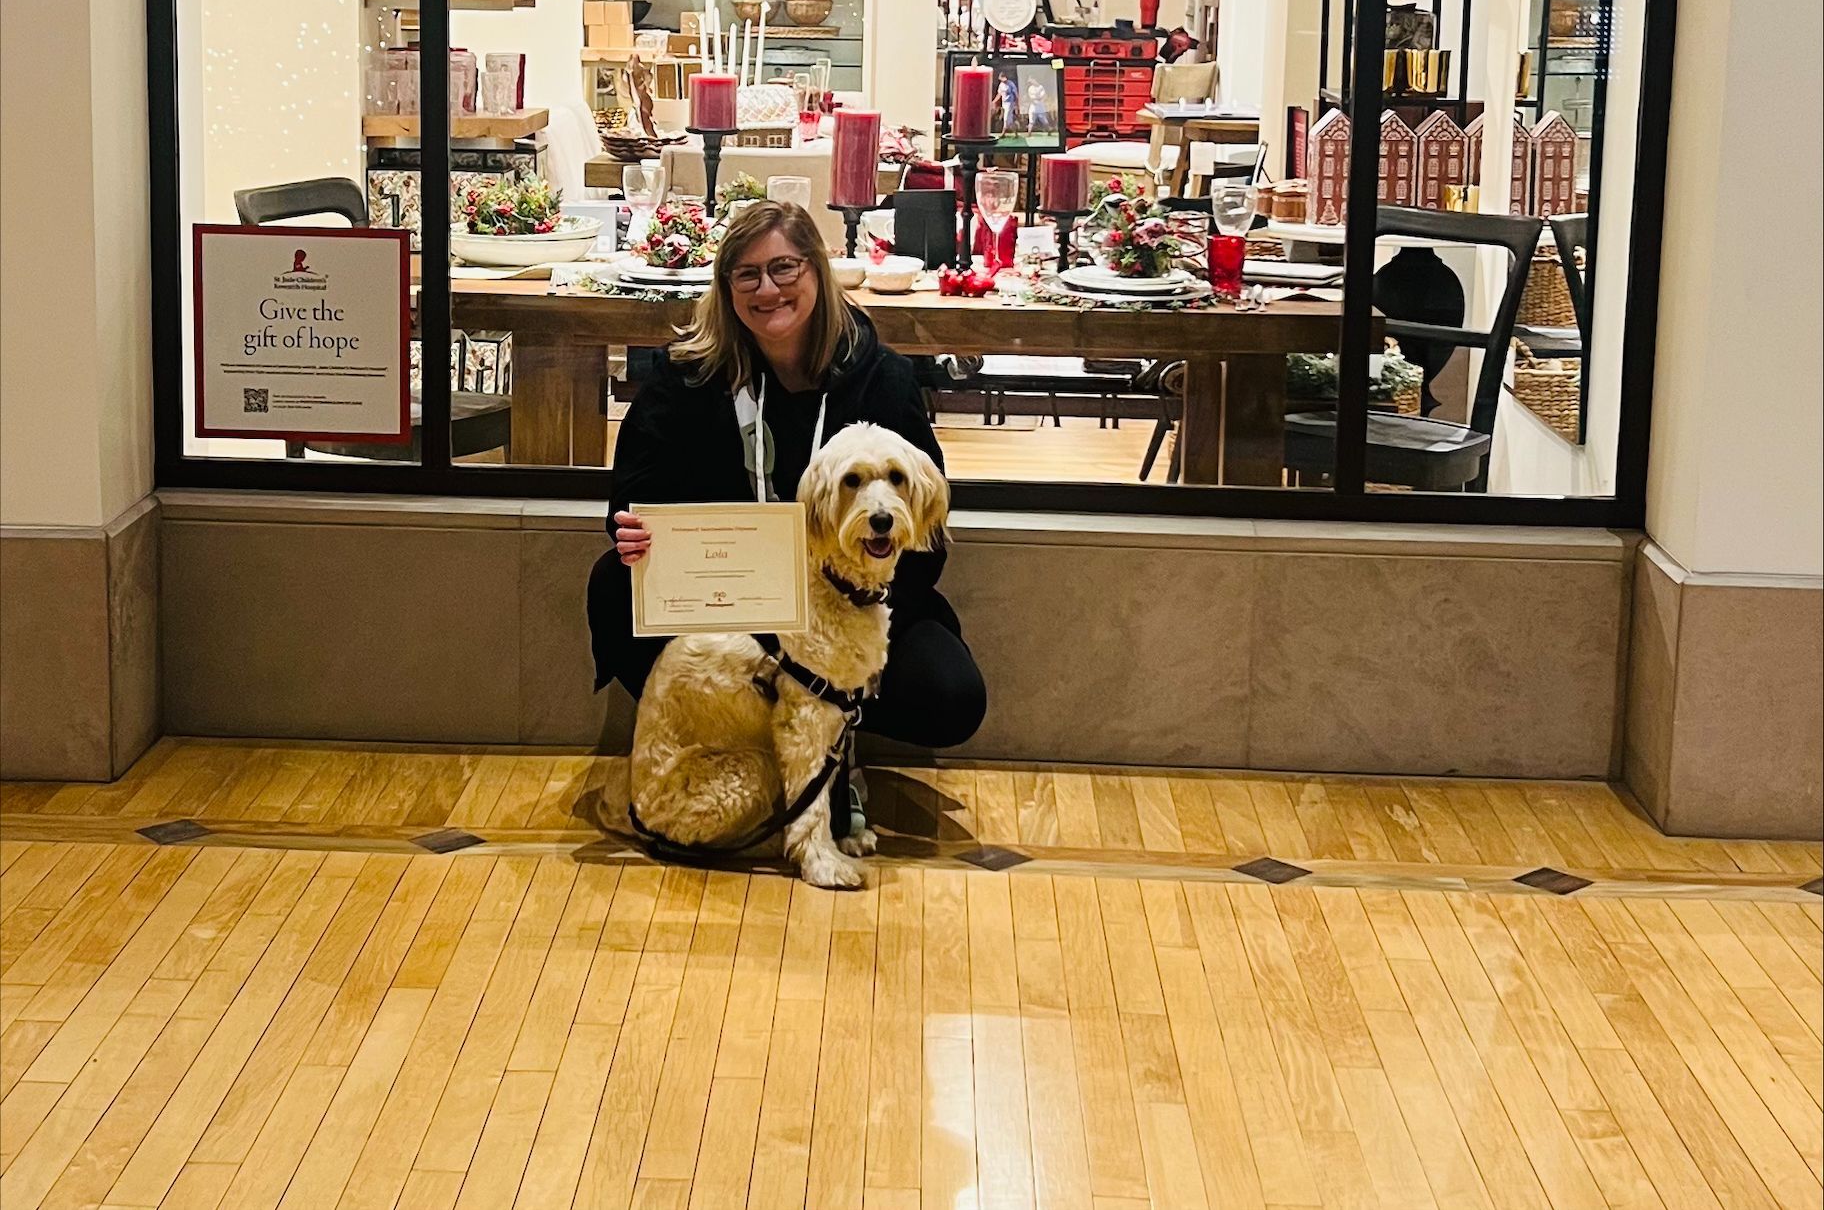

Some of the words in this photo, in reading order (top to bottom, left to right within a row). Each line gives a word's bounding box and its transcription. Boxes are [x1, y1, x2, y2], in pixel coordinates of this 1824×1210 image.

[259, 298, 307, 321] Give
[312, 298, 344, 321] the
[244, 325, 277, 356] gift
[283, 326, 306, 348] of
[309, 327, 359, 358] hope
